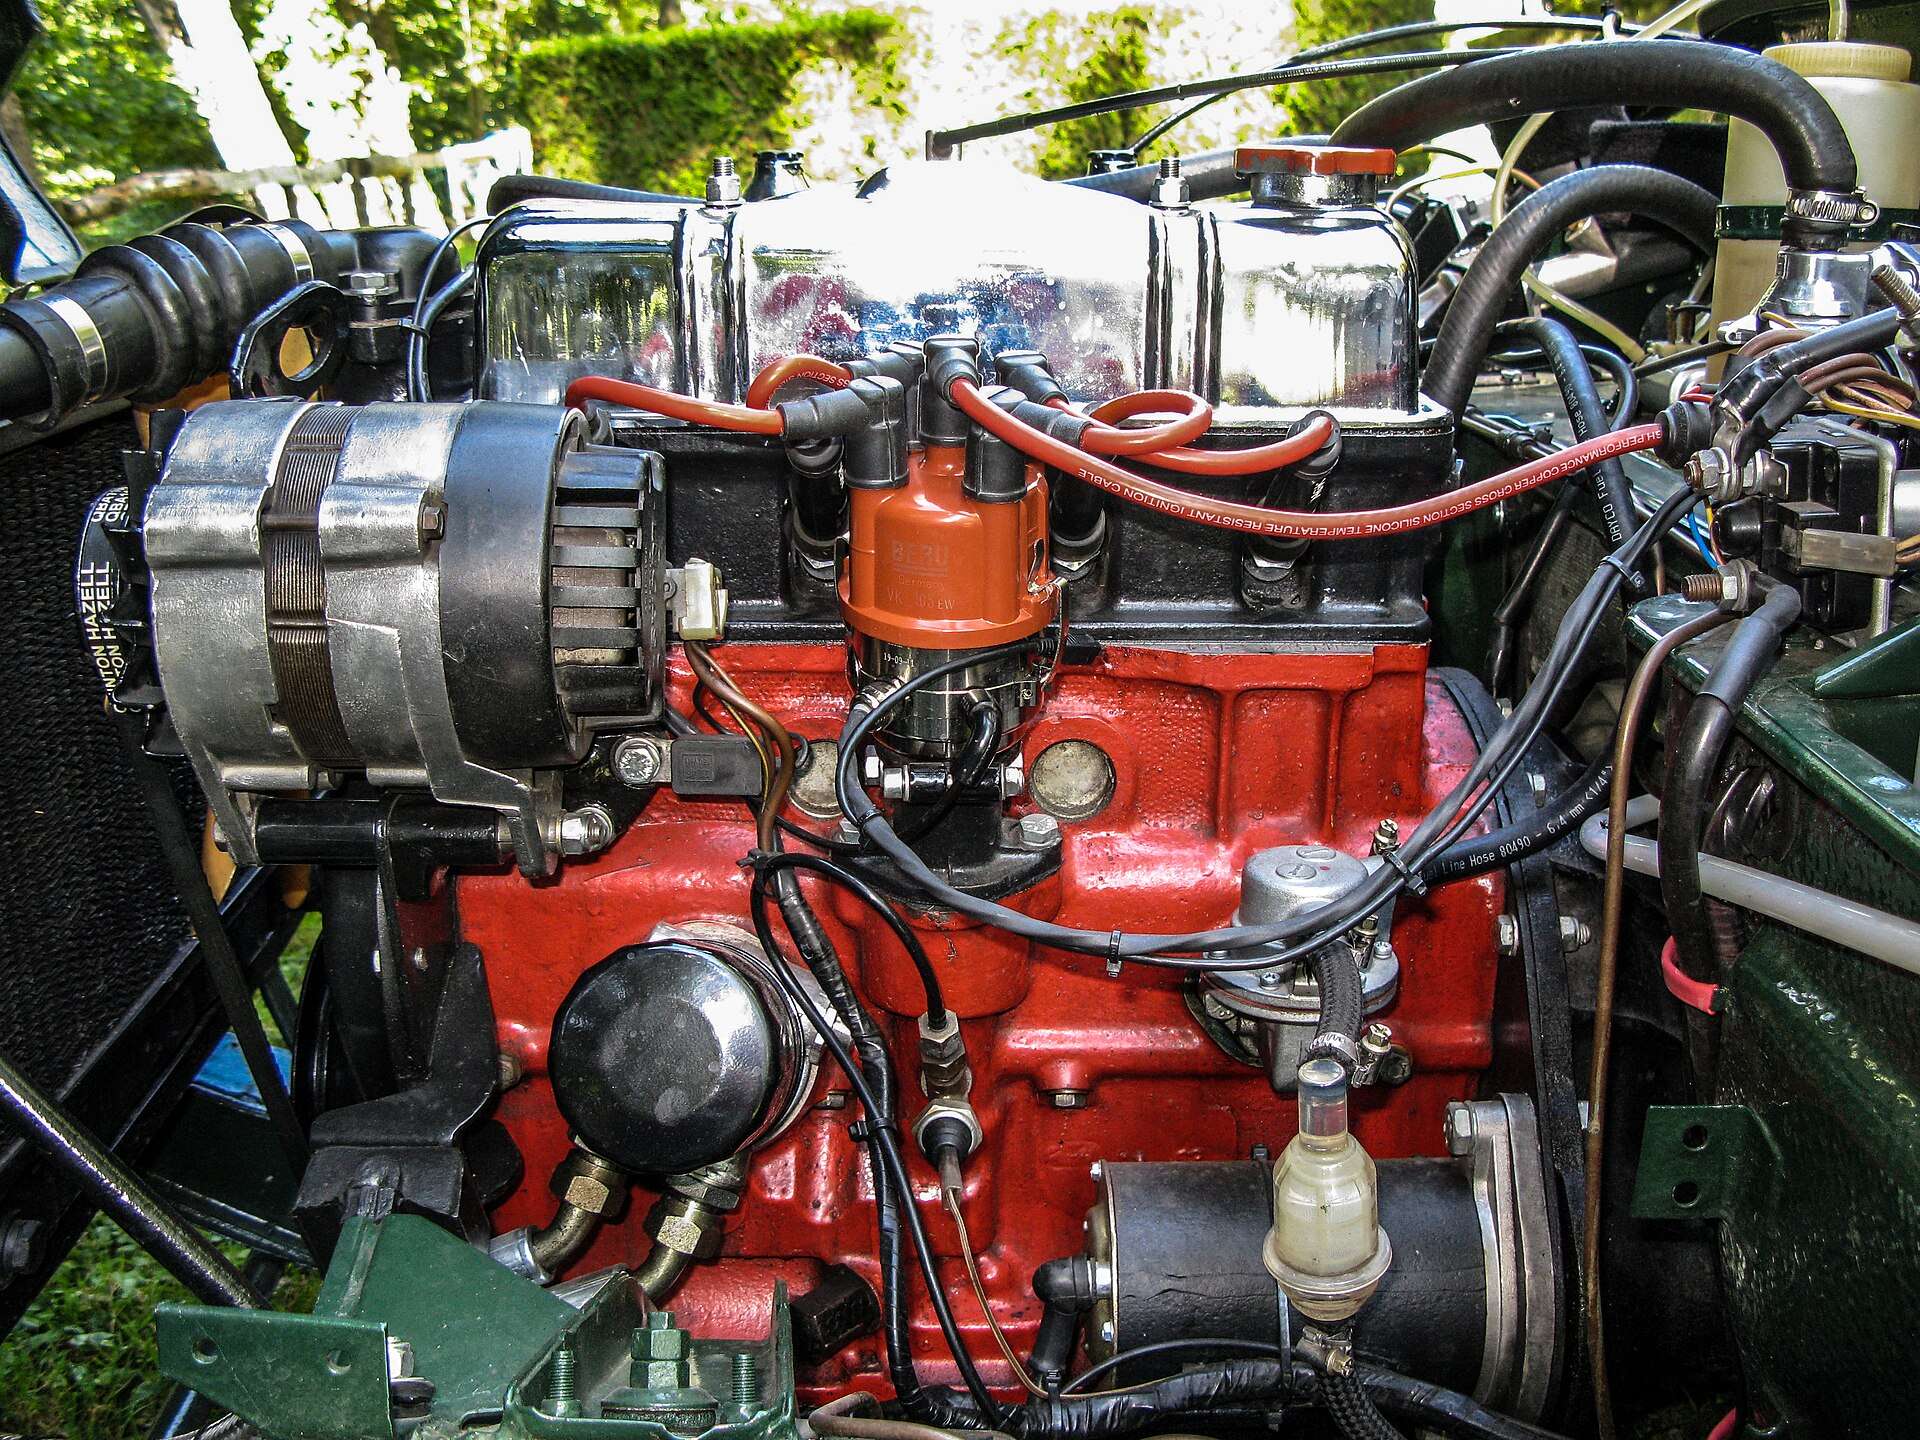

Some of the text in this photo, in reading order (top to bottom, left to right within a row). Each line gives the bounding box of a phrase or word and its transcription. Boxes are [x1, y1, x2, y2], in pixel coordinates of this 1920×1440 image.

[1574, 409, 1588, 437] Hose
[1559, 434, 1645, 473] PERFORMANCE
[1078, 468, 1121, 492] CABLE
[1515, 465, 1560, 491] COPPER
[1593, 468, 1609, 500] Fuel
[1123, 488, 1184, 515] IGNITION
[1474, 487, 1513, 507] CROSS
[1187, 509, 1263, 531] RESISTANT
[1423, 500, 1472, 523] SECTION
[1602, 503, 1622, 542] DAYCO
[1265, 523, 1362, 537] TEMPERATURE
[1365, 517, 1420, 534] SILICONE
[80, 561, 102, 640] HAZELL
[95, 561, 116, 640] HZELL
[1442, 858, 1465, 874] Line
[1469, 850, 1495, 867] Hose
[1499, 835, 1531, 858] 80490
[1569, 802, 1586, 819] mm
